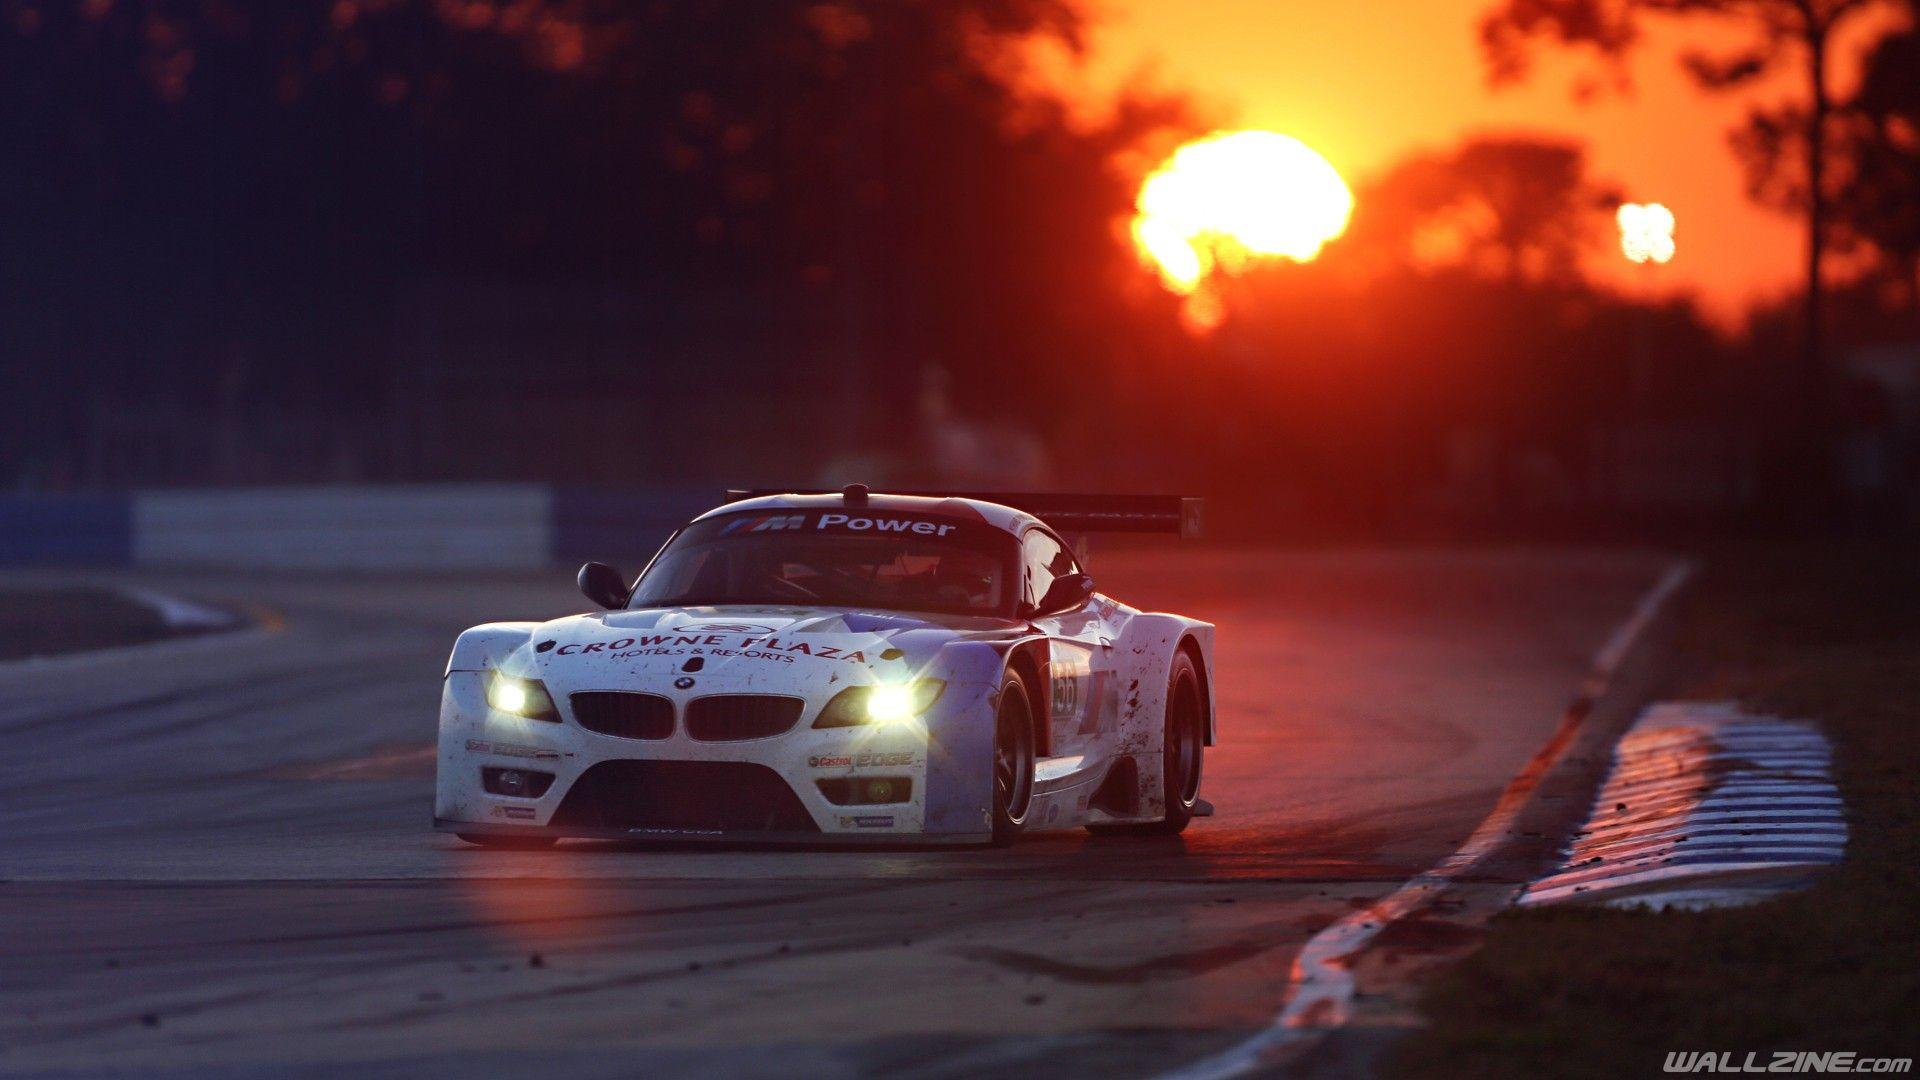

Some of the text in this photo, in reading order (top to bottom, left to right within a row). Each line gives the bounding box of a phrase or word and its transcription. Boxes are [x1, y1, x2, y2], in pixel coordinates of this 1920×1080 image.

[817, 514, 956, 537] Power
[556, 635, 866, 664] CROWNE PLAZA
[610, 648, 680, 660] HOTELS
[820, 756, 852, 767] Castrol
